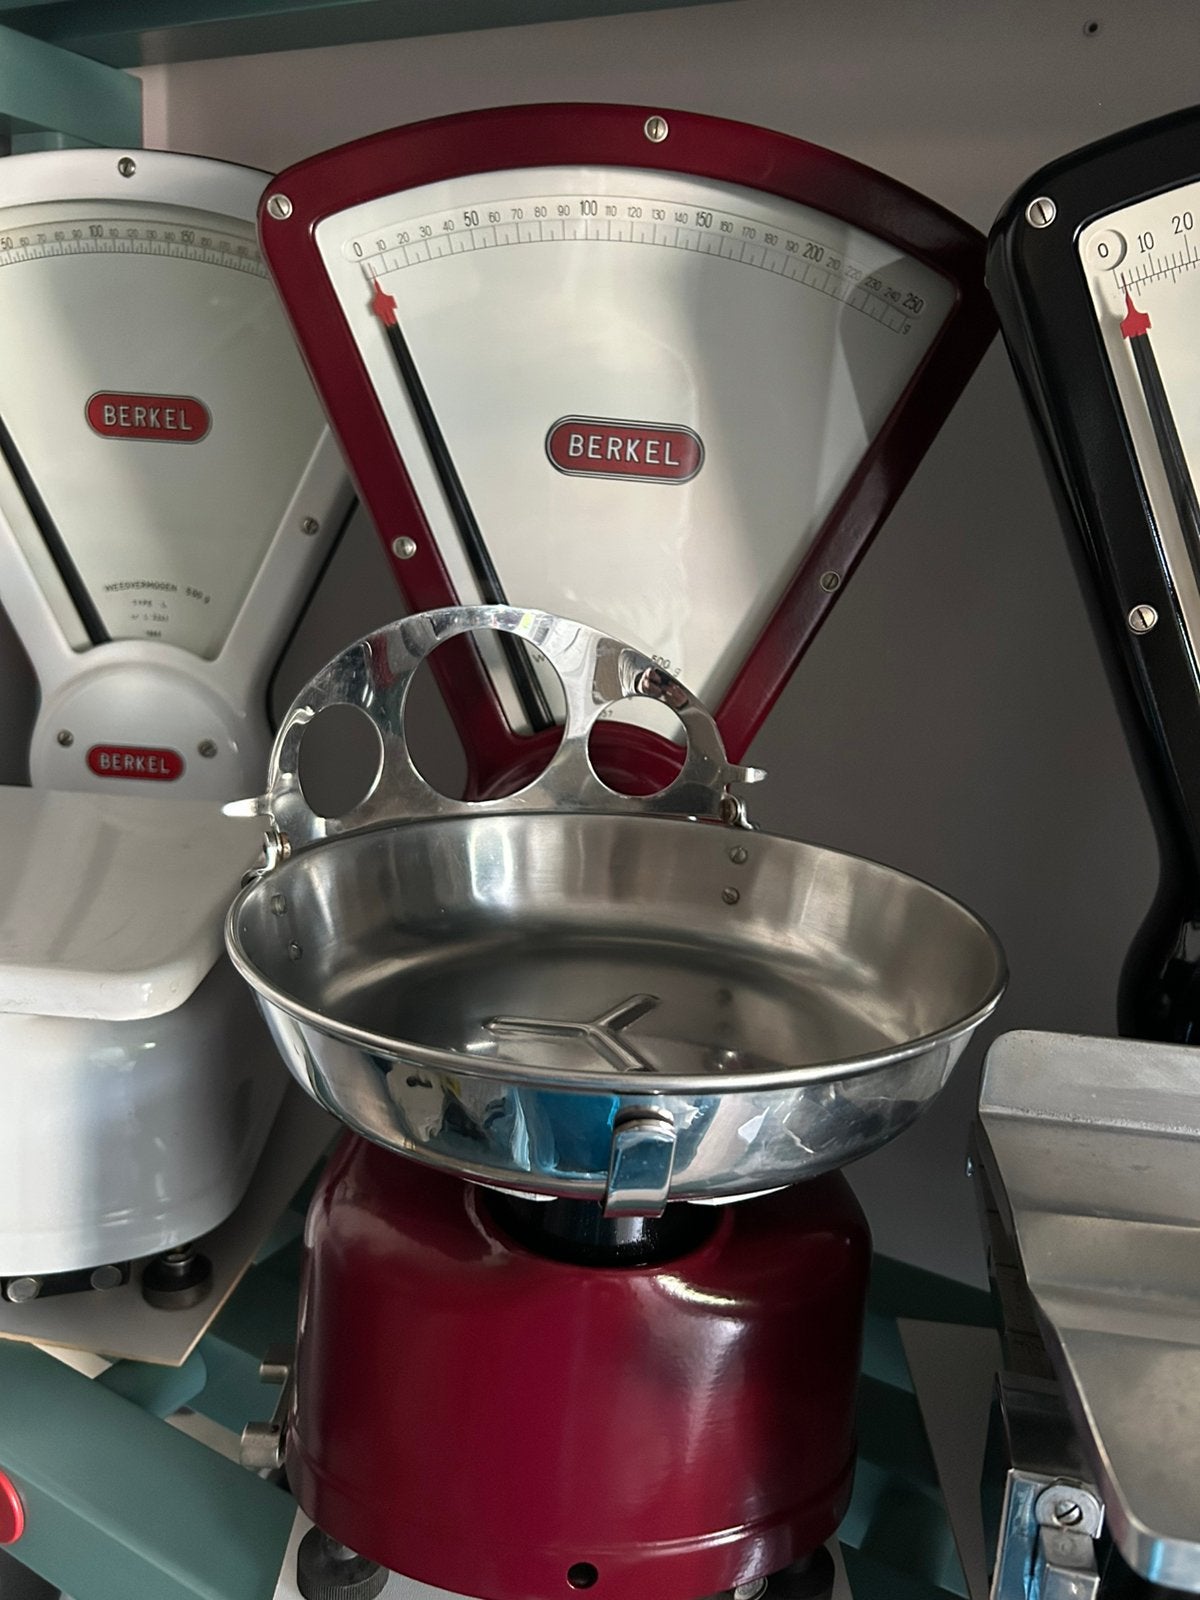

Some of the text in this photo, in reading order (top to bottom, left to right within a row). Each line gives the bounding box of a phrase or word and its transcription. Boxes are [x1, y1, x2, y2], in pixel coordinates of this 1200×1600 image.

[0, 237, 13, 250] 50
[88, 224, 104, 238] 100
[180, 230, 195, 244] 150
[1097, 211, 1194, 258] 0 10 20
[352, 242, 363, 257] 0
[376, 239, 387, 251] 10
[397, 231, 410, 245] 20
[419, 225, 433, 238] 30
[442, 219, 455, 232] 40
[463, 210, 480, 227] 50
[488, 211, 501, 223] 60
[511, 208, 524, 220] 70
[534, 206, 547, 218] 80
[557, 204, 570, 217] 90
[579, 200, 598, 216] 100
[605, 205, 617, 217] 110
[627, 206, 642, 219] 120
[652, 209, 666, 221] 130
[674, 212, 688, 224] 140
[695, 212, 713, 229] 150
[720, 220, 734, 234] 160
[742, 226, 757, 240] 170
[764, 233, 778, 246] 180
[785, 240, 799, 254] 190
[802, 243, 825, 263] 200
[826, 256, 841, 271] 210
[864, 276, 882, 291] 230
[902, 292, 925, 314] 250
[104, 405, 192, 430] BERKEL
[568, 434, 679, 465] BERKEL
[100, 752, 171, 774] BERKEL
